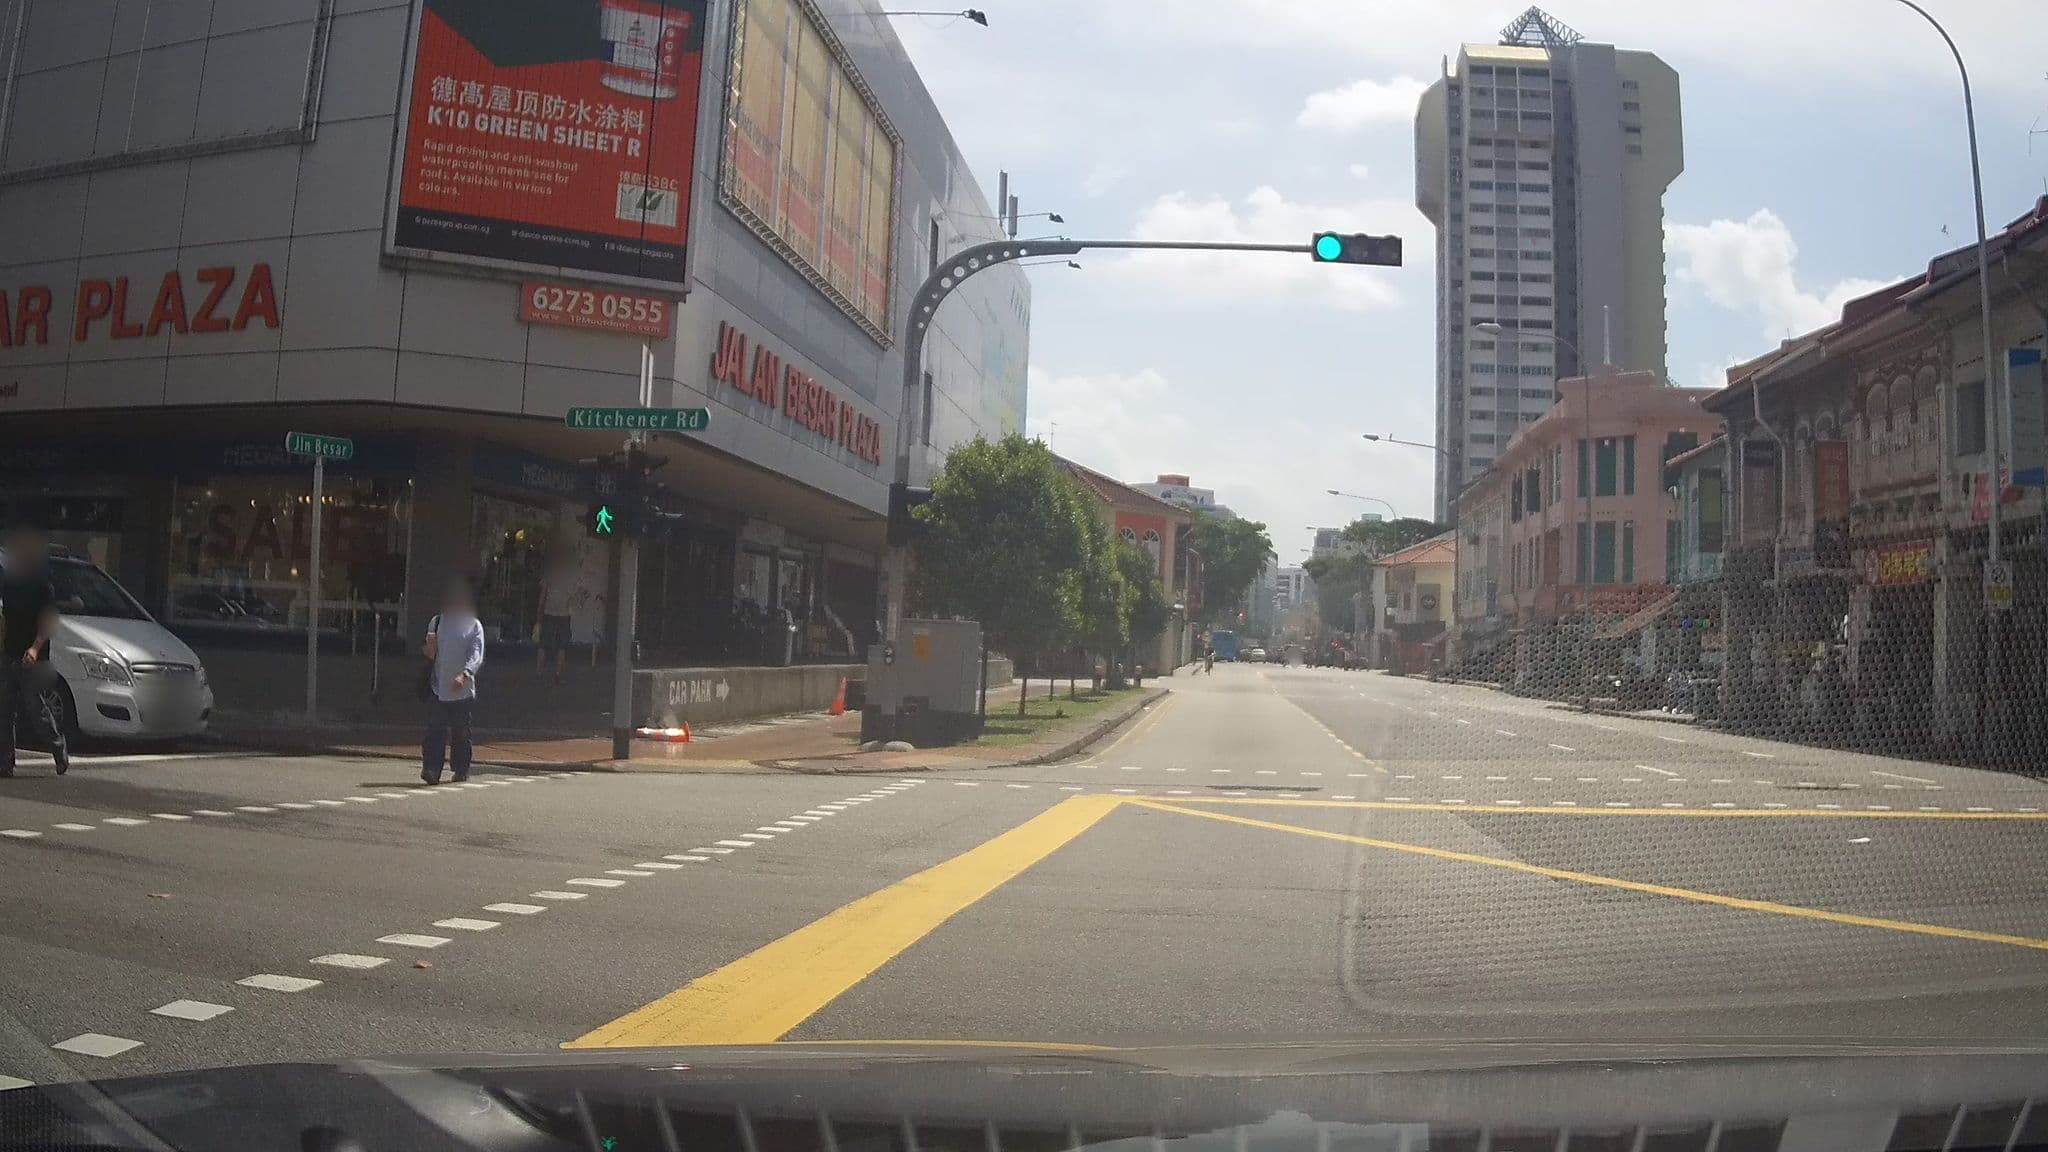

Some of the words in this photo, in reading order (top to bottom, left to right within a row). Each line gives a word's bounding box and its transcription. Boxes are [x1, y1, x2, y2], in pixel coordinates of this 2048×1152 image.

[431, 75, 645, 135] 德高屋顶防水涂料
[428, 105, 469, 129] K10
[474, 113, 548, 142] GREEN
[553, 126, 622, 153] SHEET
[627, 138, 641, 157] R
[423, 138, 453, 153] Rapid
[455, 144, 488, 159] drying
[489, 150, 509, 161] and
[421, 154, 493, 174] waterproofing
[496, 165, 553, 182] membrane
[554, 173, 569, 184] for
[418, 181, 460, 196] colours.
[452, 171, 498, 187] Available
[501, 178, 512, 190] in
[514, 181, 553, 195] various
[0, 285, 52, 347] R
[75, 263, 280, 342] PLAZA
[532, 285, 595, 315] 6273
[600, 293, 663, 324] 0555
[711, 320, 779, 409] JALAN
[783, 363, 839, 440] BESAR
[839, 399, 881, 466] PLAZA
[574, 408, 668, 428] Kitchener
[676, 409, 700, 428] Rd
[294, 435, 311, 451] Jln
[315, 438, 348, 456] Besar
[669, 680, 687, 705] CAR
[689, 680, 712, 704] PARK
